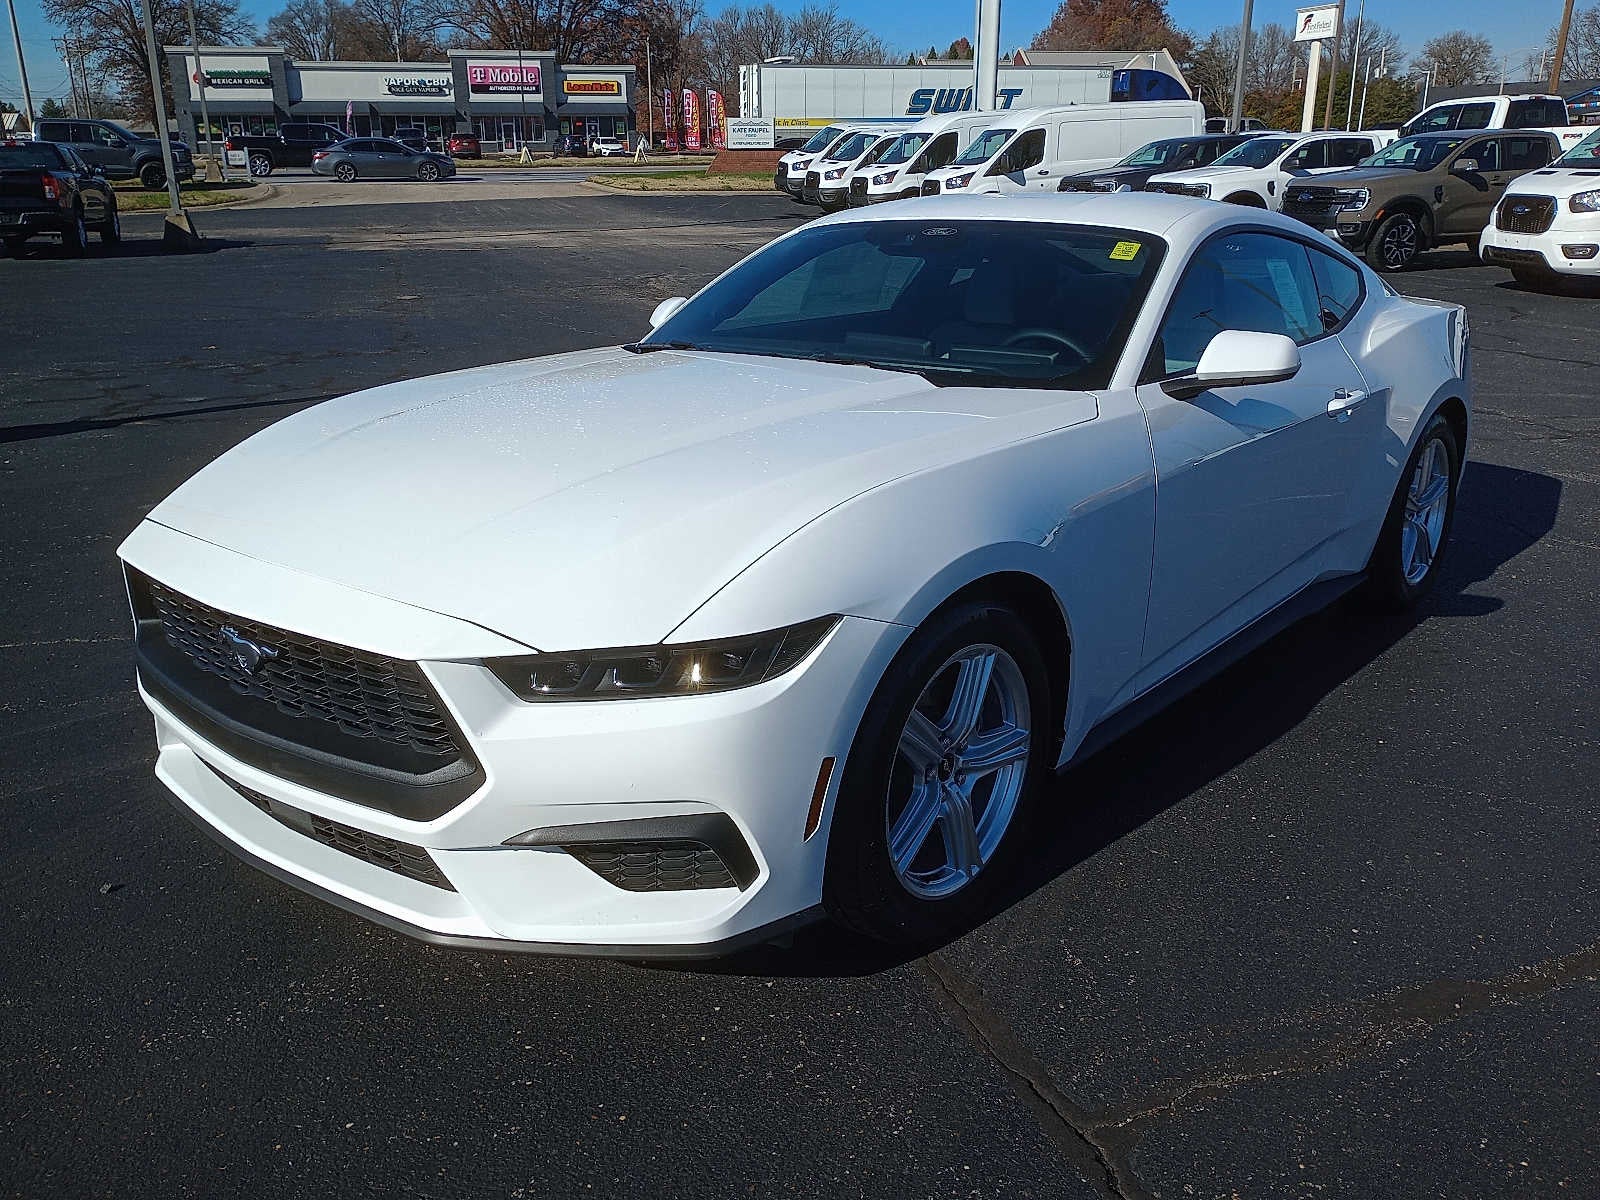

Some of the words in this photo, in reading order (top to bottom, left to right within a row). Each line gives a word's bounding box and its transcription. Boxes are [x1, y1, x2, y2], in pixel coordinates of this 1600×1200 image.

[384, 77, 419, 86] VAPOR
[425, 78, 447, 86] CBD
[905, 86, 1024, 115] SWIT
